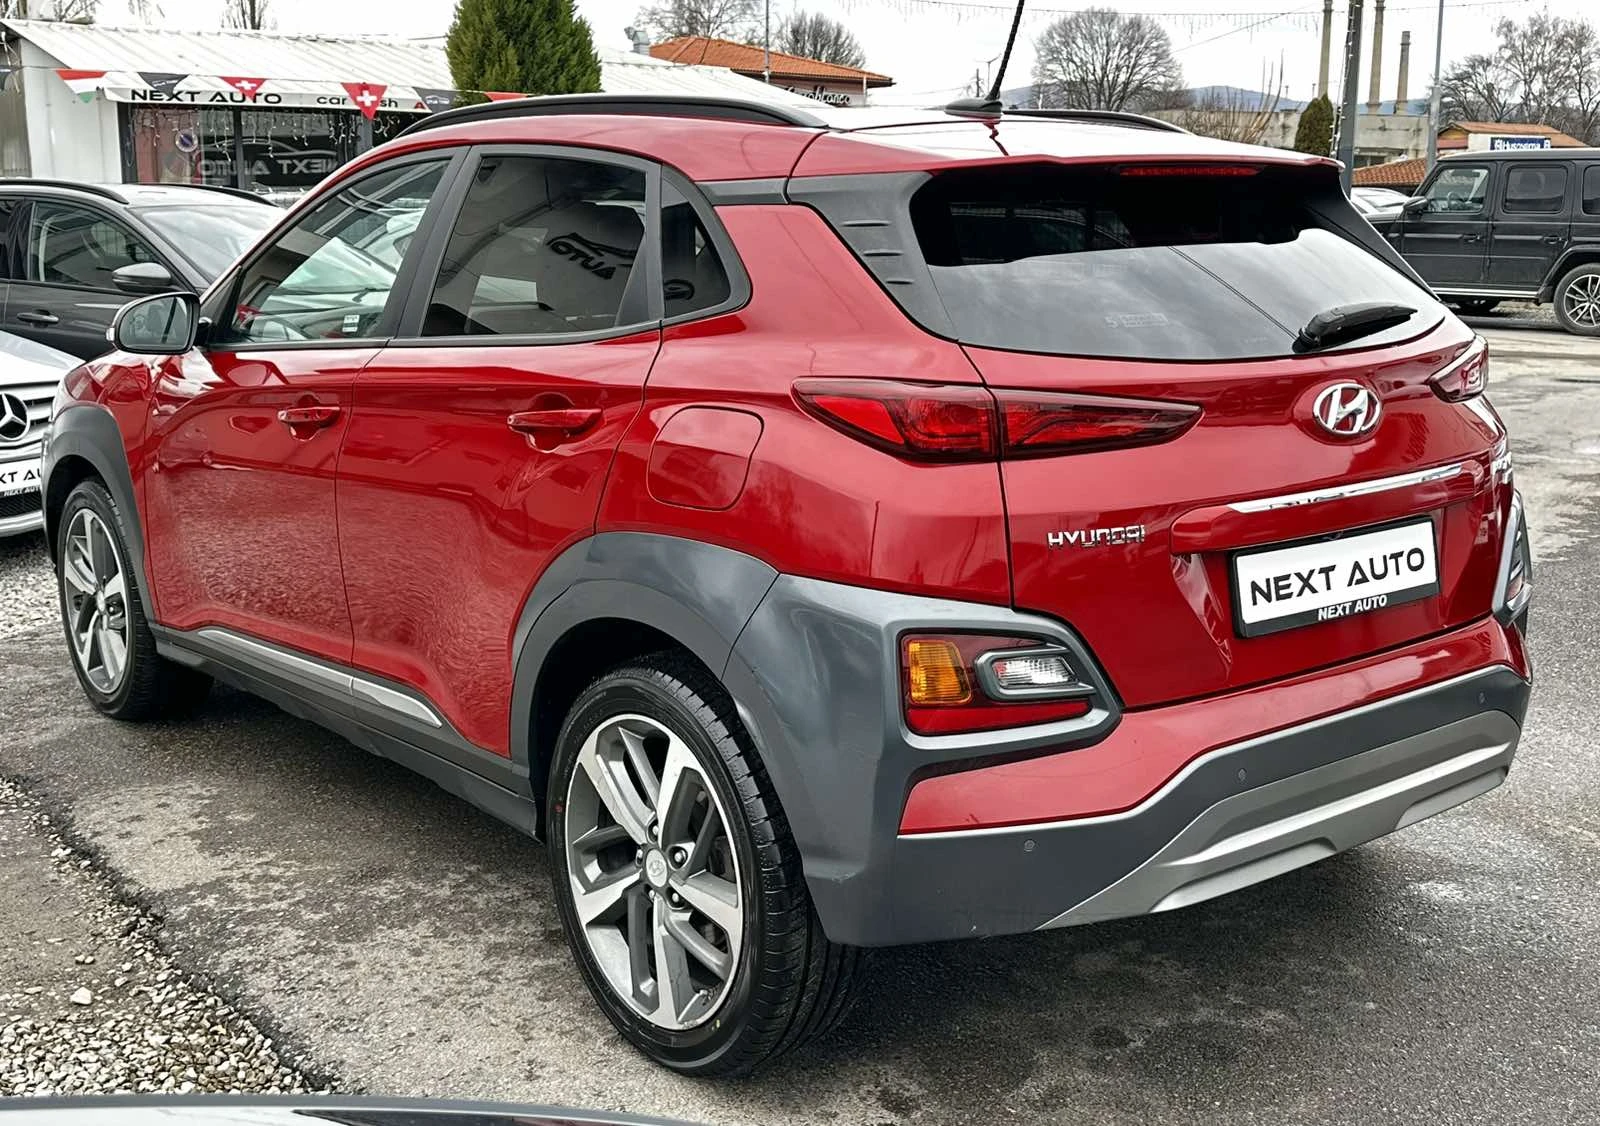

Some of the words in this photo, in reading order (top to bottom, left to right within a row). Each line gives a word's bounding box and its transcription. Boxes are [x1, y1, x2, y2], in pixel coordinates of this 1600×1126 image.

[131, 89, 201, 102] NEXT
[208, 91, 282, 104] AUTO
[316, 96, 346, 105] car
[1047, 525, 1145, 547] HYUNDAI
[1250, 564, 1337, 606] NEXT
[1347, 547, 1425, 587] AUTO
[1318, 602, 1352, 621] NEXT
[1354, 594, 1388, 613] AUTO
